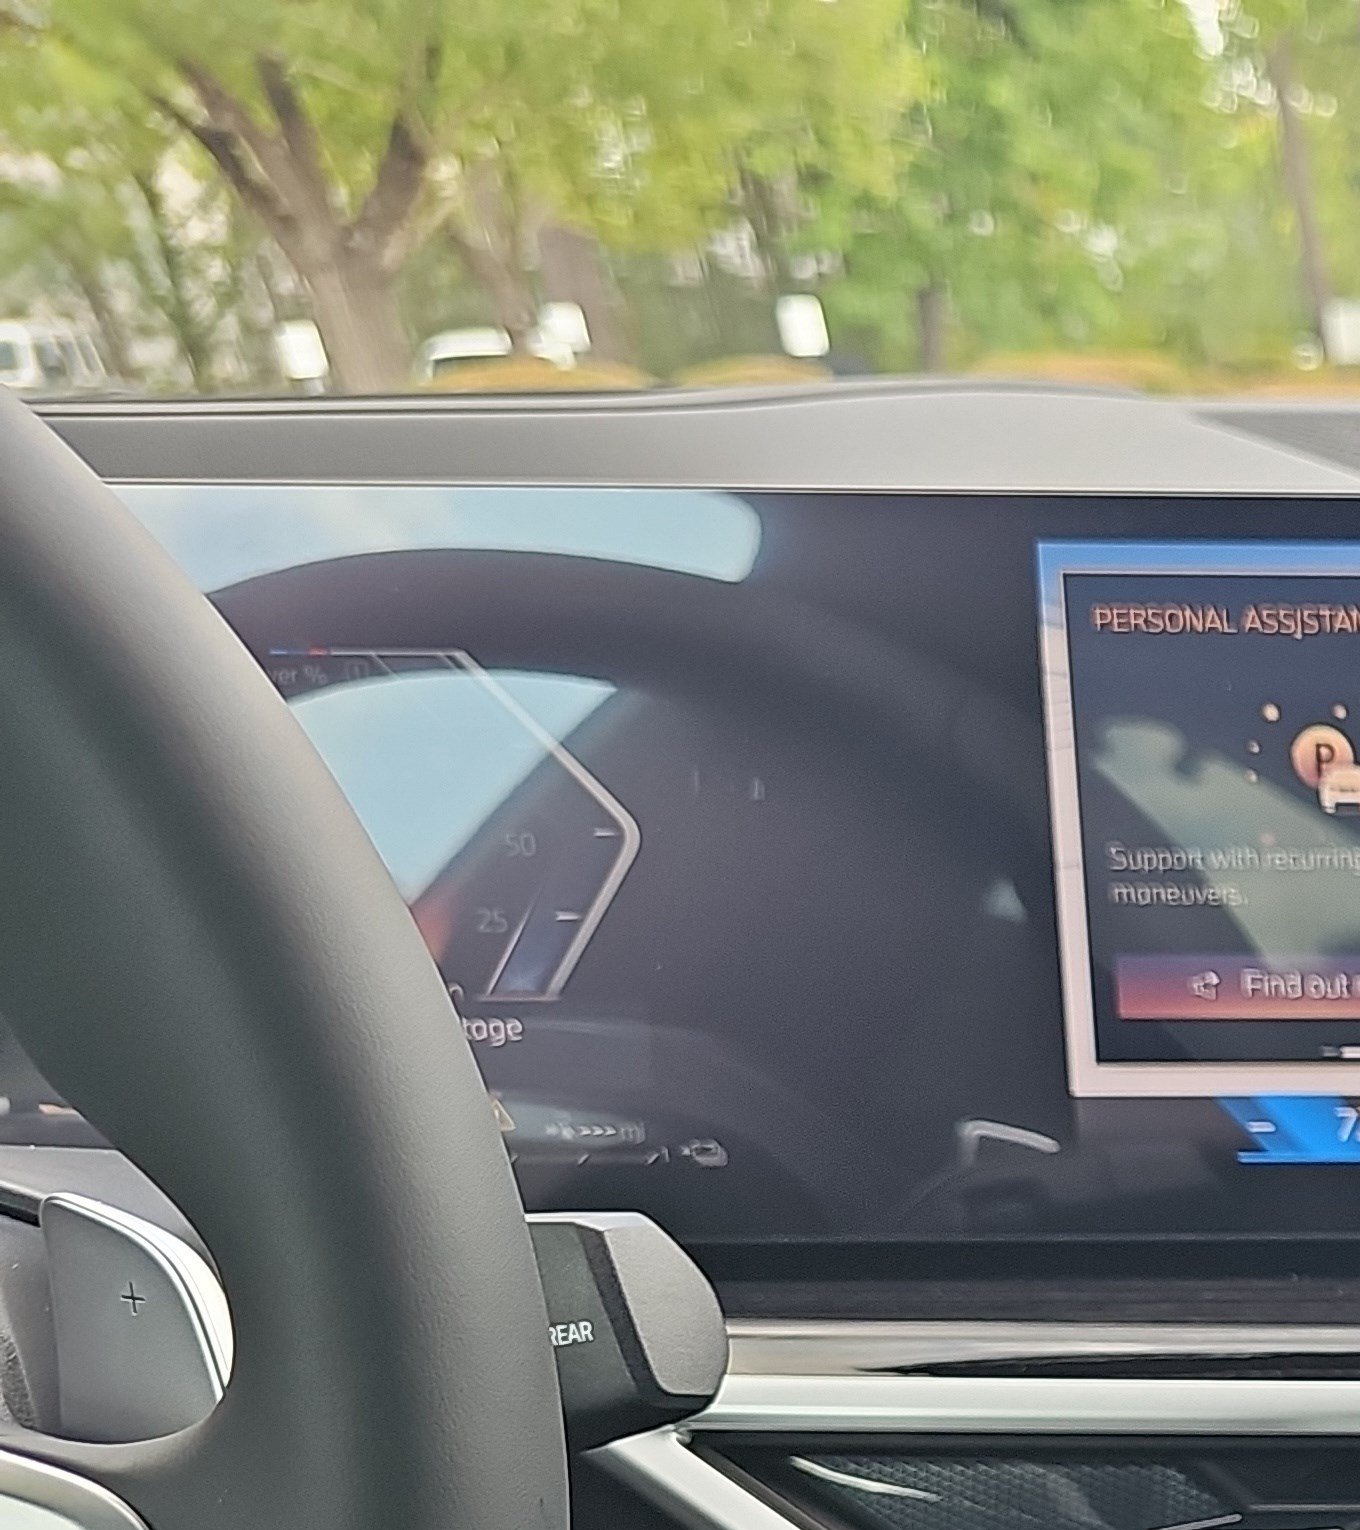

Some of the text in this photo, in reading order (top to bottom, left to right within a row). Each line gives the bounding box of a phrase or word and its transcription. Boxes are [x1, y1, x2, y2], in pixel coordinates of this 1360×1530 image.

[1094, 607, 1236, 634] PERSONAL
[505, 832, 536, 856] 50
[1108, 847, 1203, 875] Support
[1211, 846, 1259, 870] with
[476, 908, 508, 933] 25
[1244, 969, 1301, 998] Find
[1311, 973, 1350, 998] out
[549, 1321, 594, 1346] REAR
